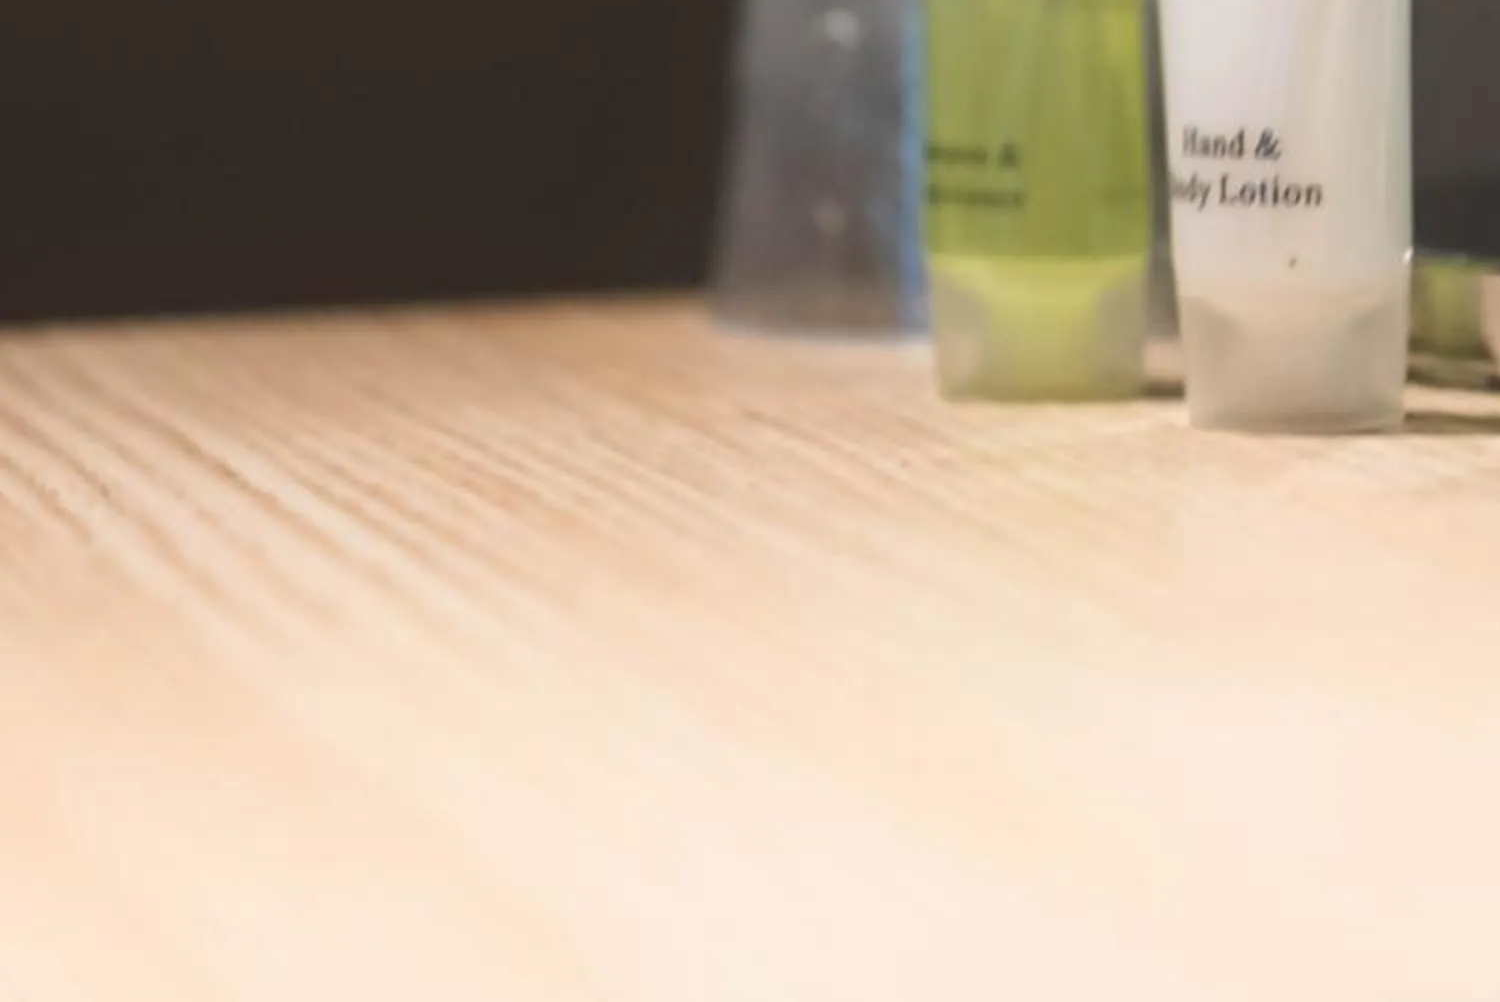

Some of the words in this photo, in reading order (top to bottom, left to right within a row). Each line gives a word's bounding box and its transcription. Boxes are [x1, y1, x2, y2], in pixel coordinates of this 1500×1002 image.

[1181, 125, 1245, 160] Hand
[1254, 127, 1283, 161] &
[1218, 173, 1324, 209] Lotion
